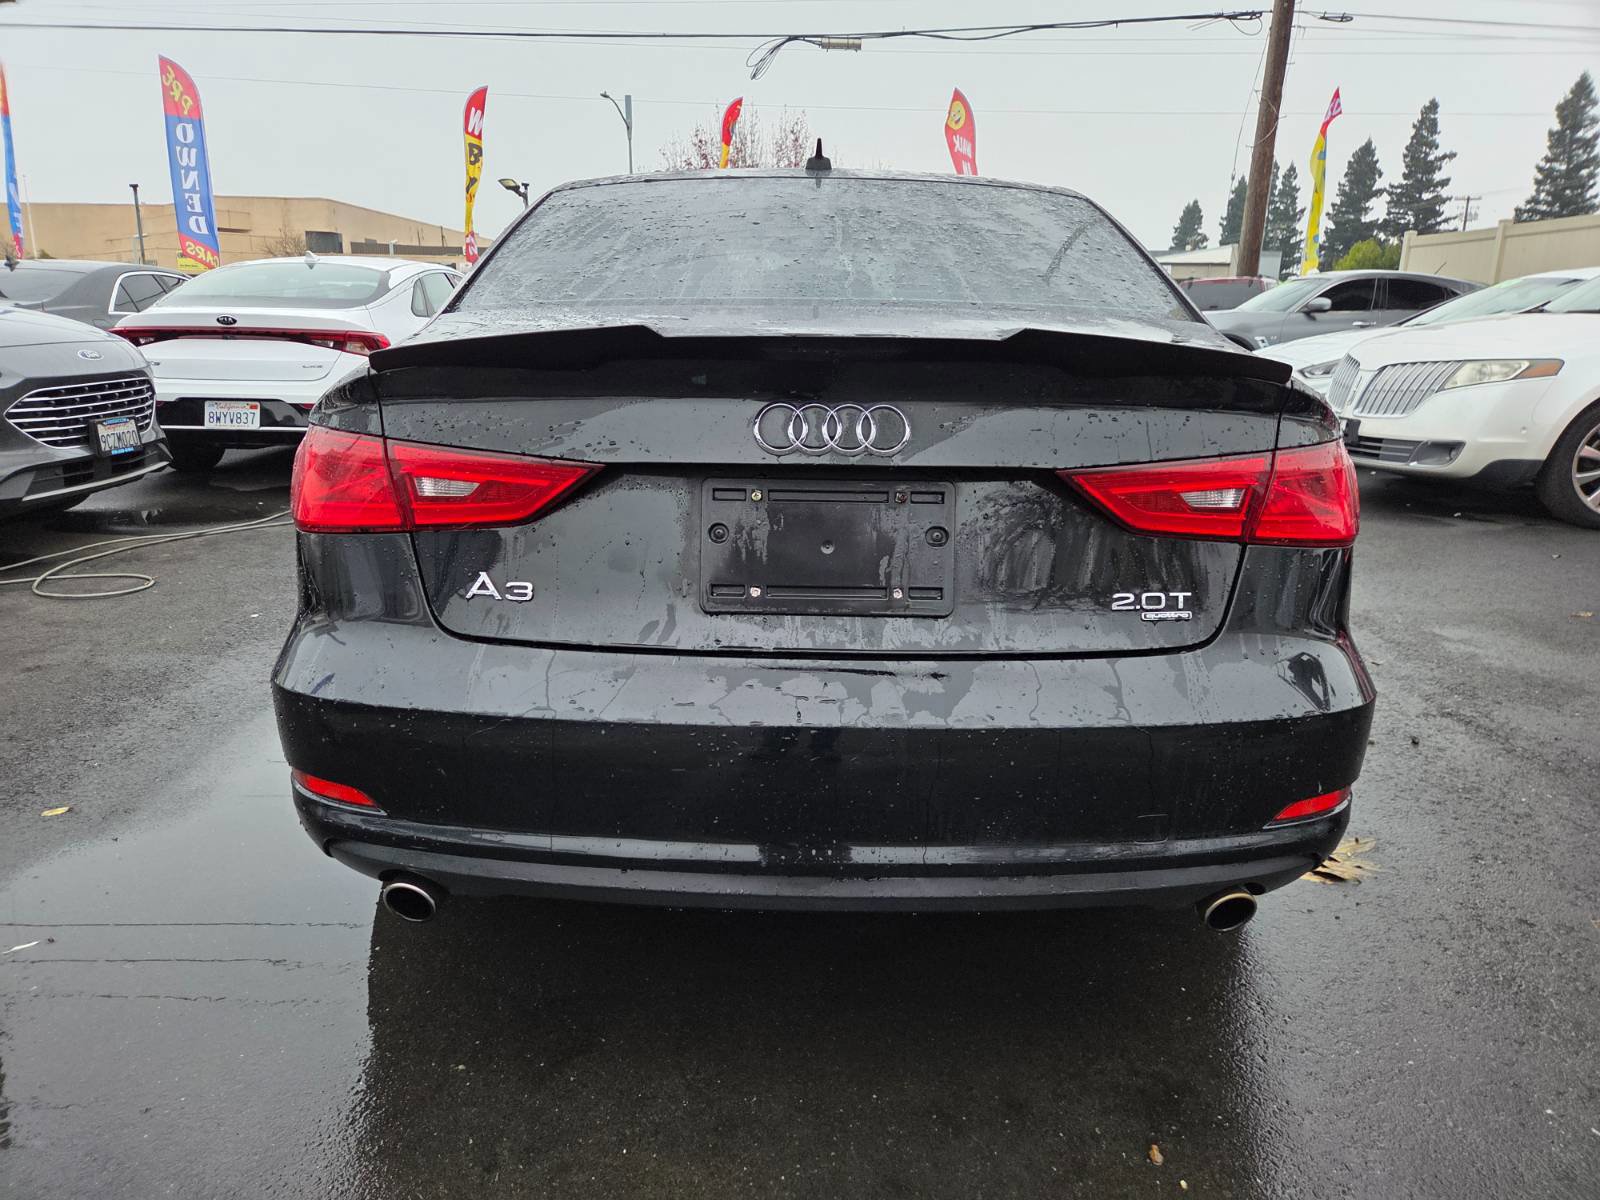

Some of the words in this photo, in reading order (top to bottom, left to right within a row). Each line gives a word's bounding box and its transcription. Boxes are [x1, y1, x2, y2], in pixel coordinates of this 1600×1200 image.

[208, 411, 256, 425] 8WYV837
[100, 430, 139, 451] 9CZM020
[465, 571, 533, 601] A3
[1111, 592, 1192, 611] 2.0T
